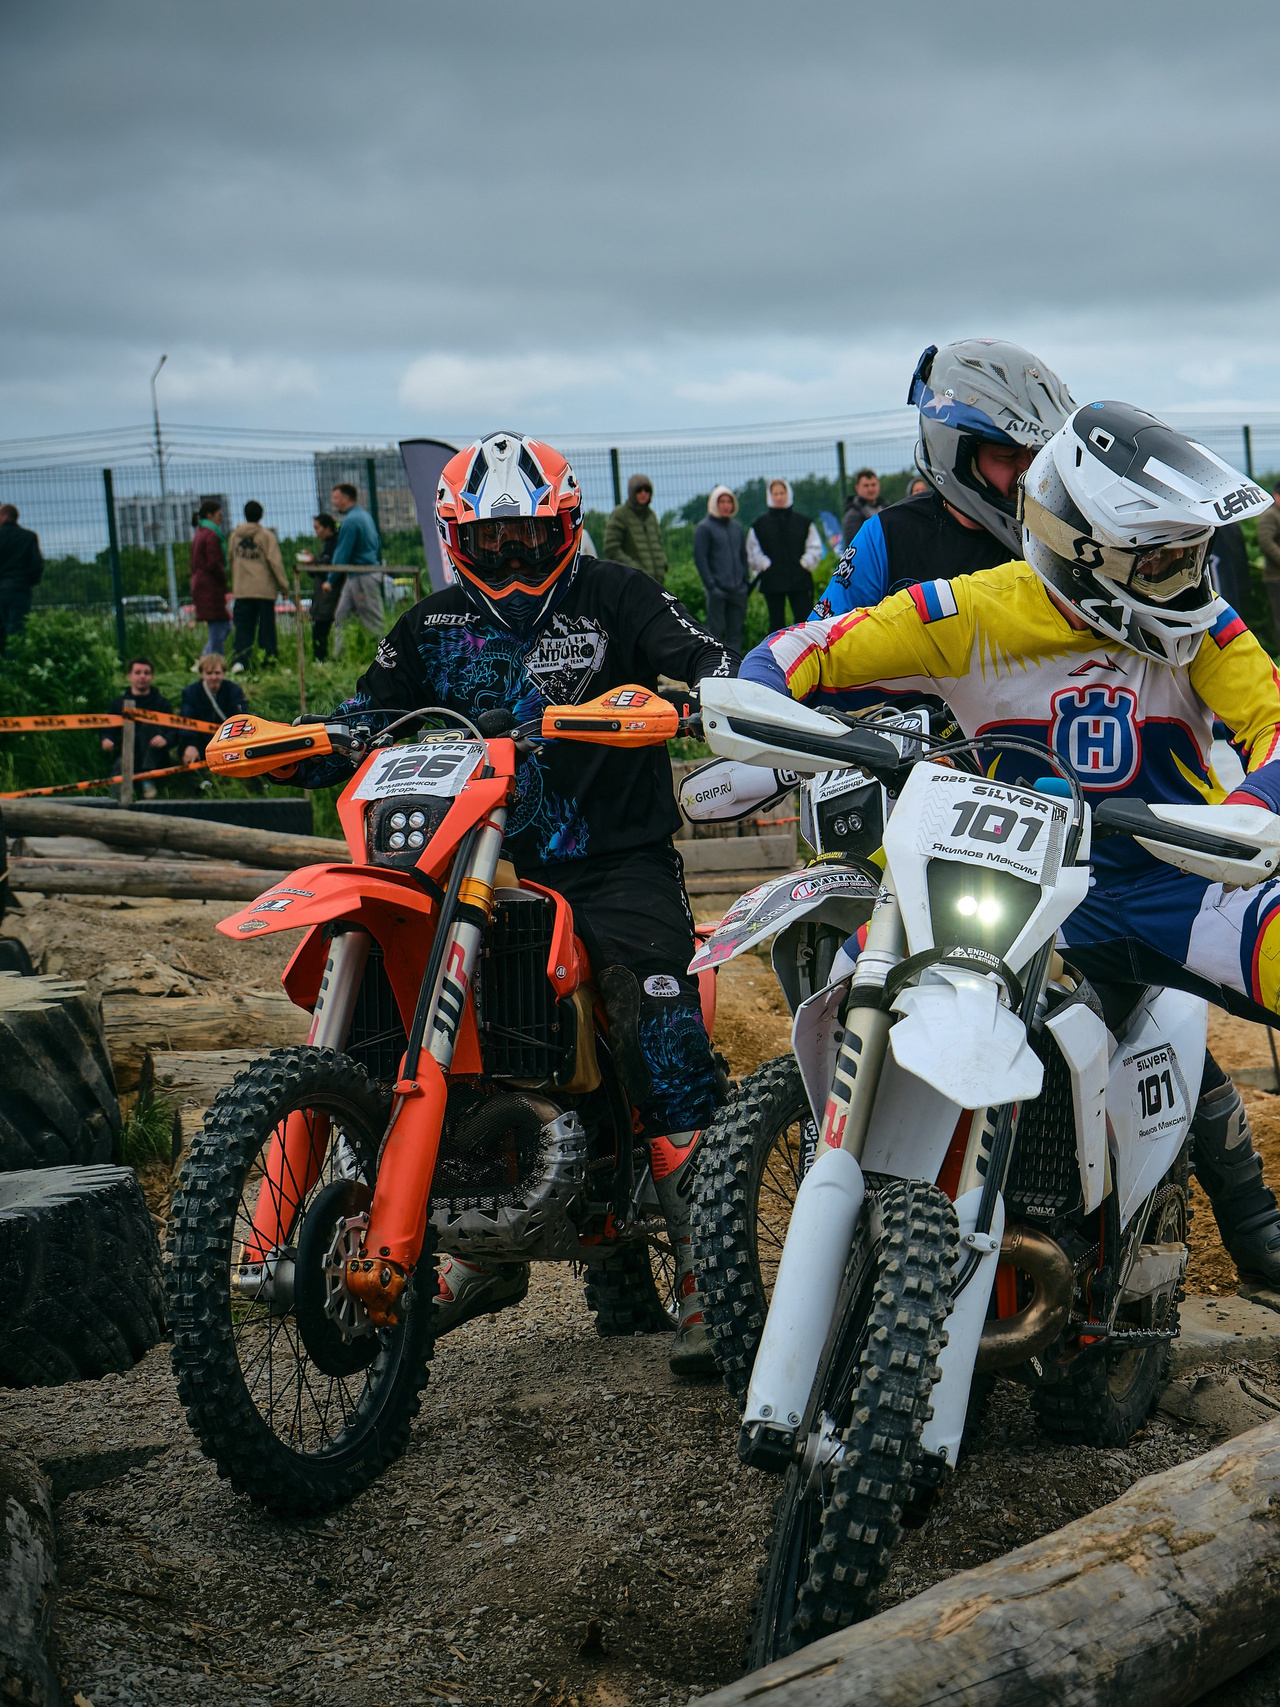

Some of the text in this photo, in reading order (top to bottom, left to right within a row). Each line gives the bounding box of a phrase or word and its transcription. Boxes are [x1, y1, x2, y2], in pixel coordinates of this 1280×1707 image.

[1005, 420, 1055, 441] AIRO
[375, 754, 466, 785] 126
[820, 778, 864, 798] Александр
[951, 800, 1045, 852] 101
[931, 843, 1038, 876] Якимов Максим
[967, 947, 1000, 964] ENDURO
[969, 954, 999, 968] ELEMENT
[1138, 1069, 1175, 1119] 101
[1158, 1116, 1187, 1130] Максим
